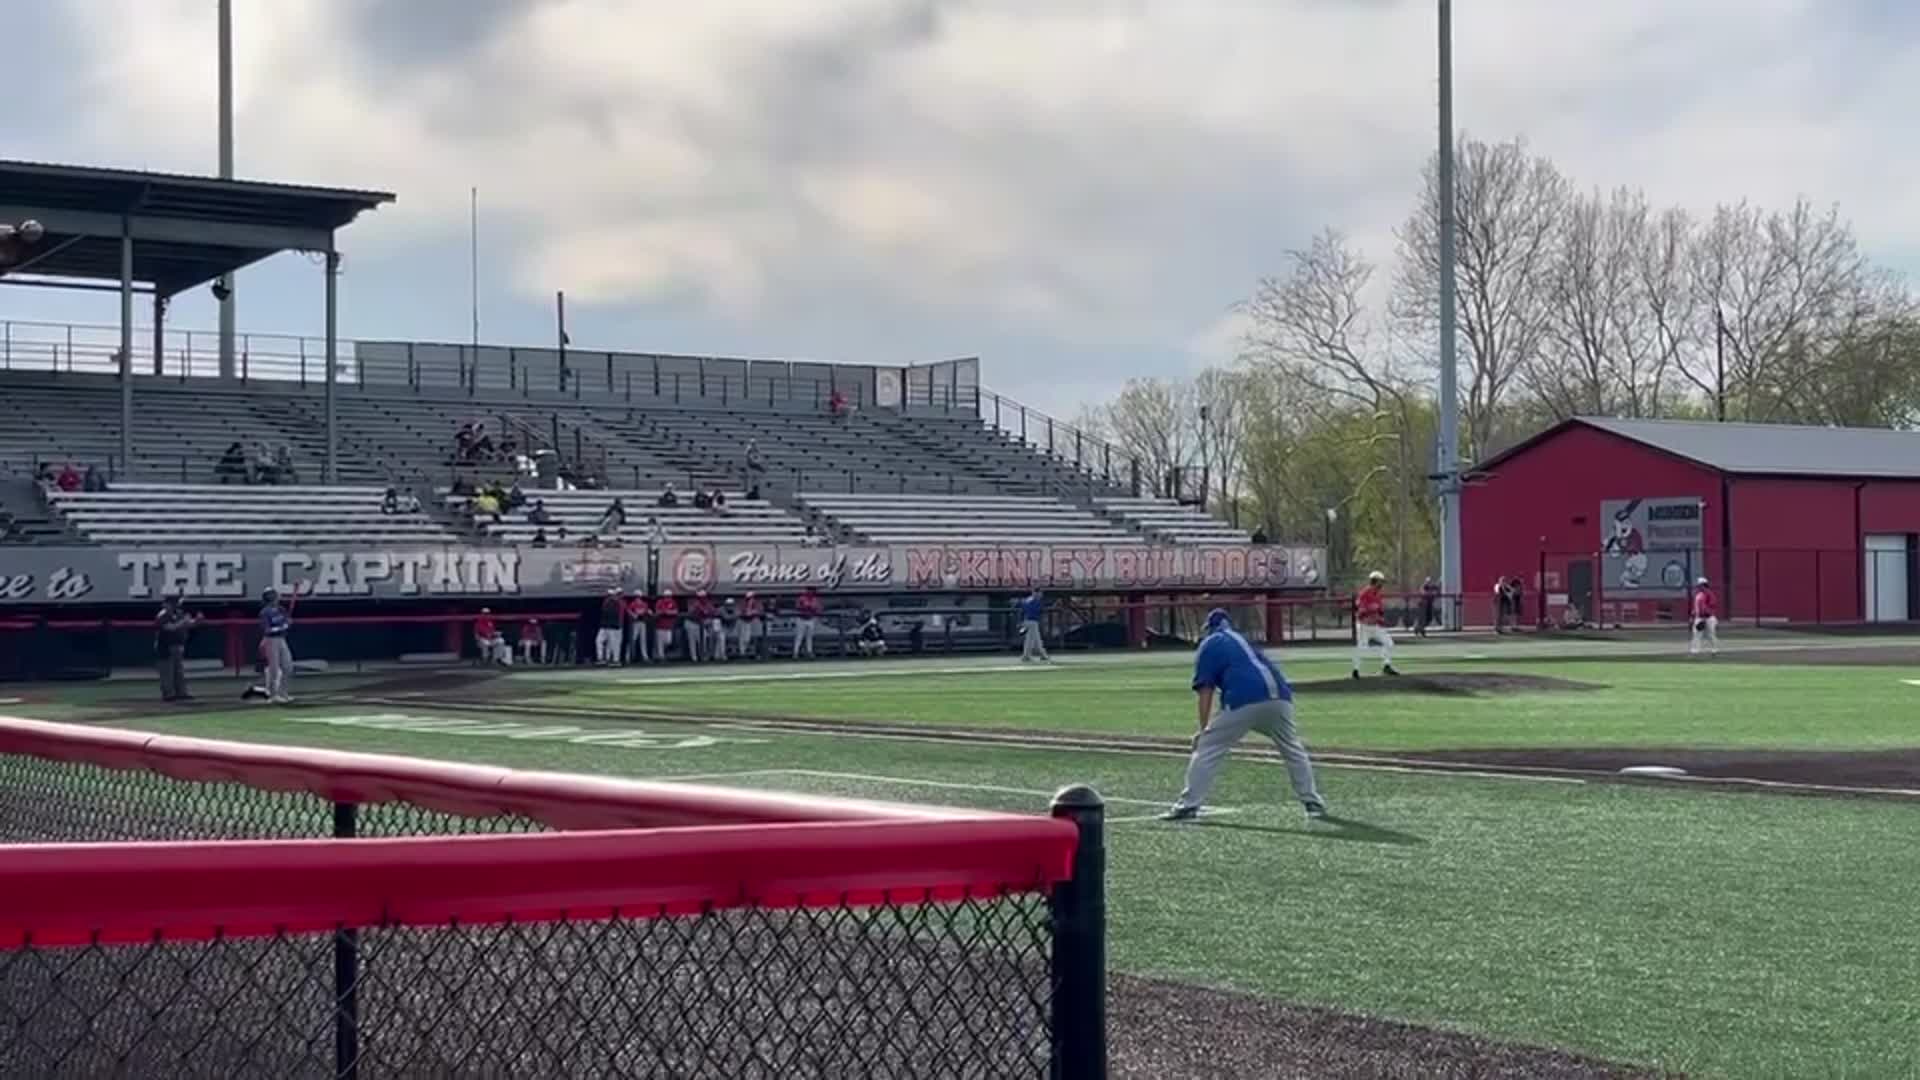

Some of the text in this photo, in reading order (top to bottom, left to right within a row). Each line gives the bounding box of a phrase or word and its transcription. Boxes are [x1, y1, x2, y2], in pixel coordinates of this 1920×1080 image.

[47, 567, 93, 598] to
[118, 552, 246, 597] THE
[272, 551, 521, 597] CAPTAIN
[730, 552, 810, 581] Home
[817, 552, 847, 588] of
[851, 553, 890, 581] the
[1114, 548, 1288, 586] BULLDOGS
